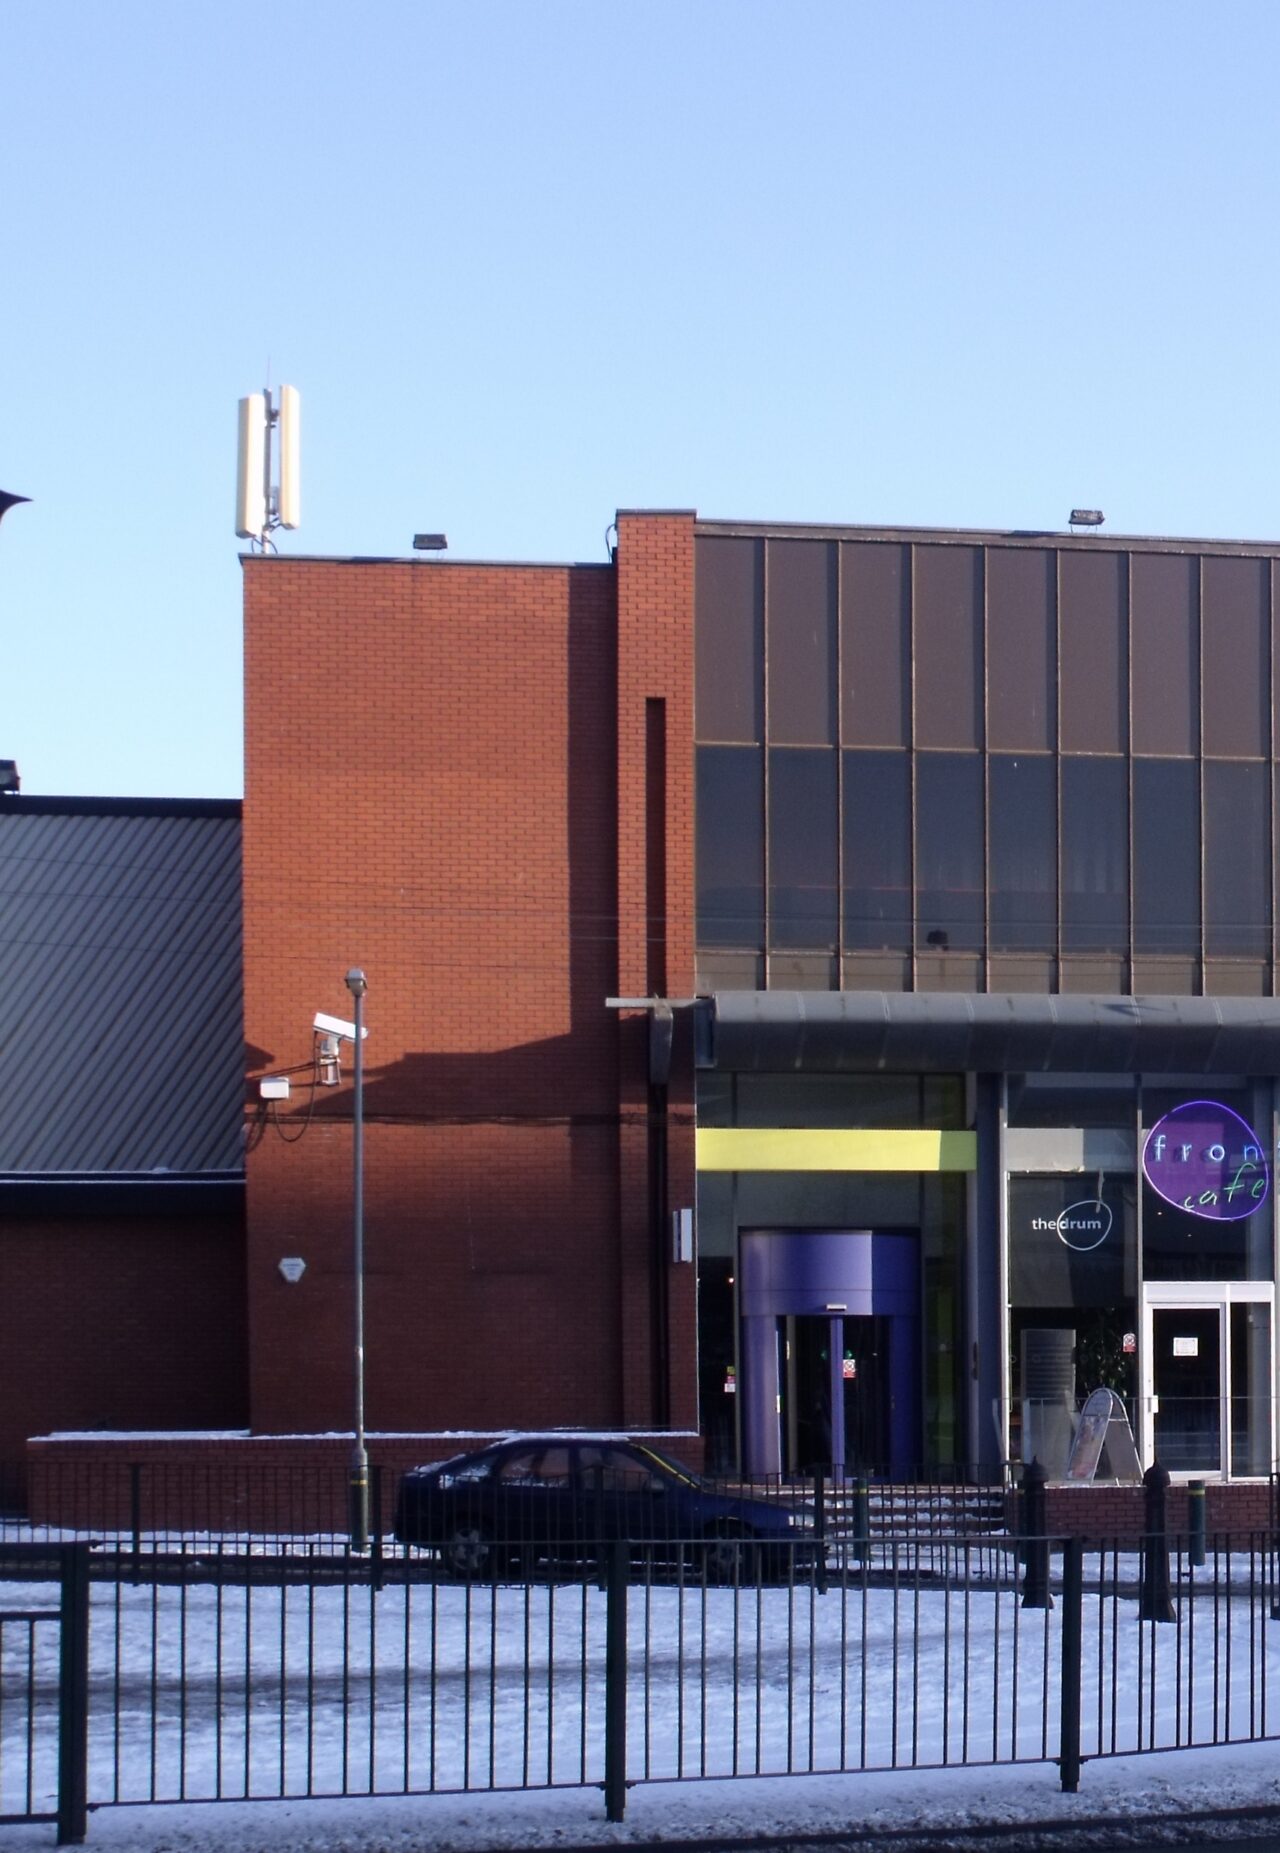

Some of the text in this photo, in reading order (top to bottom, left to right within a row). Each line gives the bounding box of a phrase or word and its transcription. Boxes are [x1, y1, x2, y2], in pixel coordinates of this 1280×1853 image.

[1183, 1163, 1265, 1209] cafe
[1031, 1217, 1102, 1230] the drum
